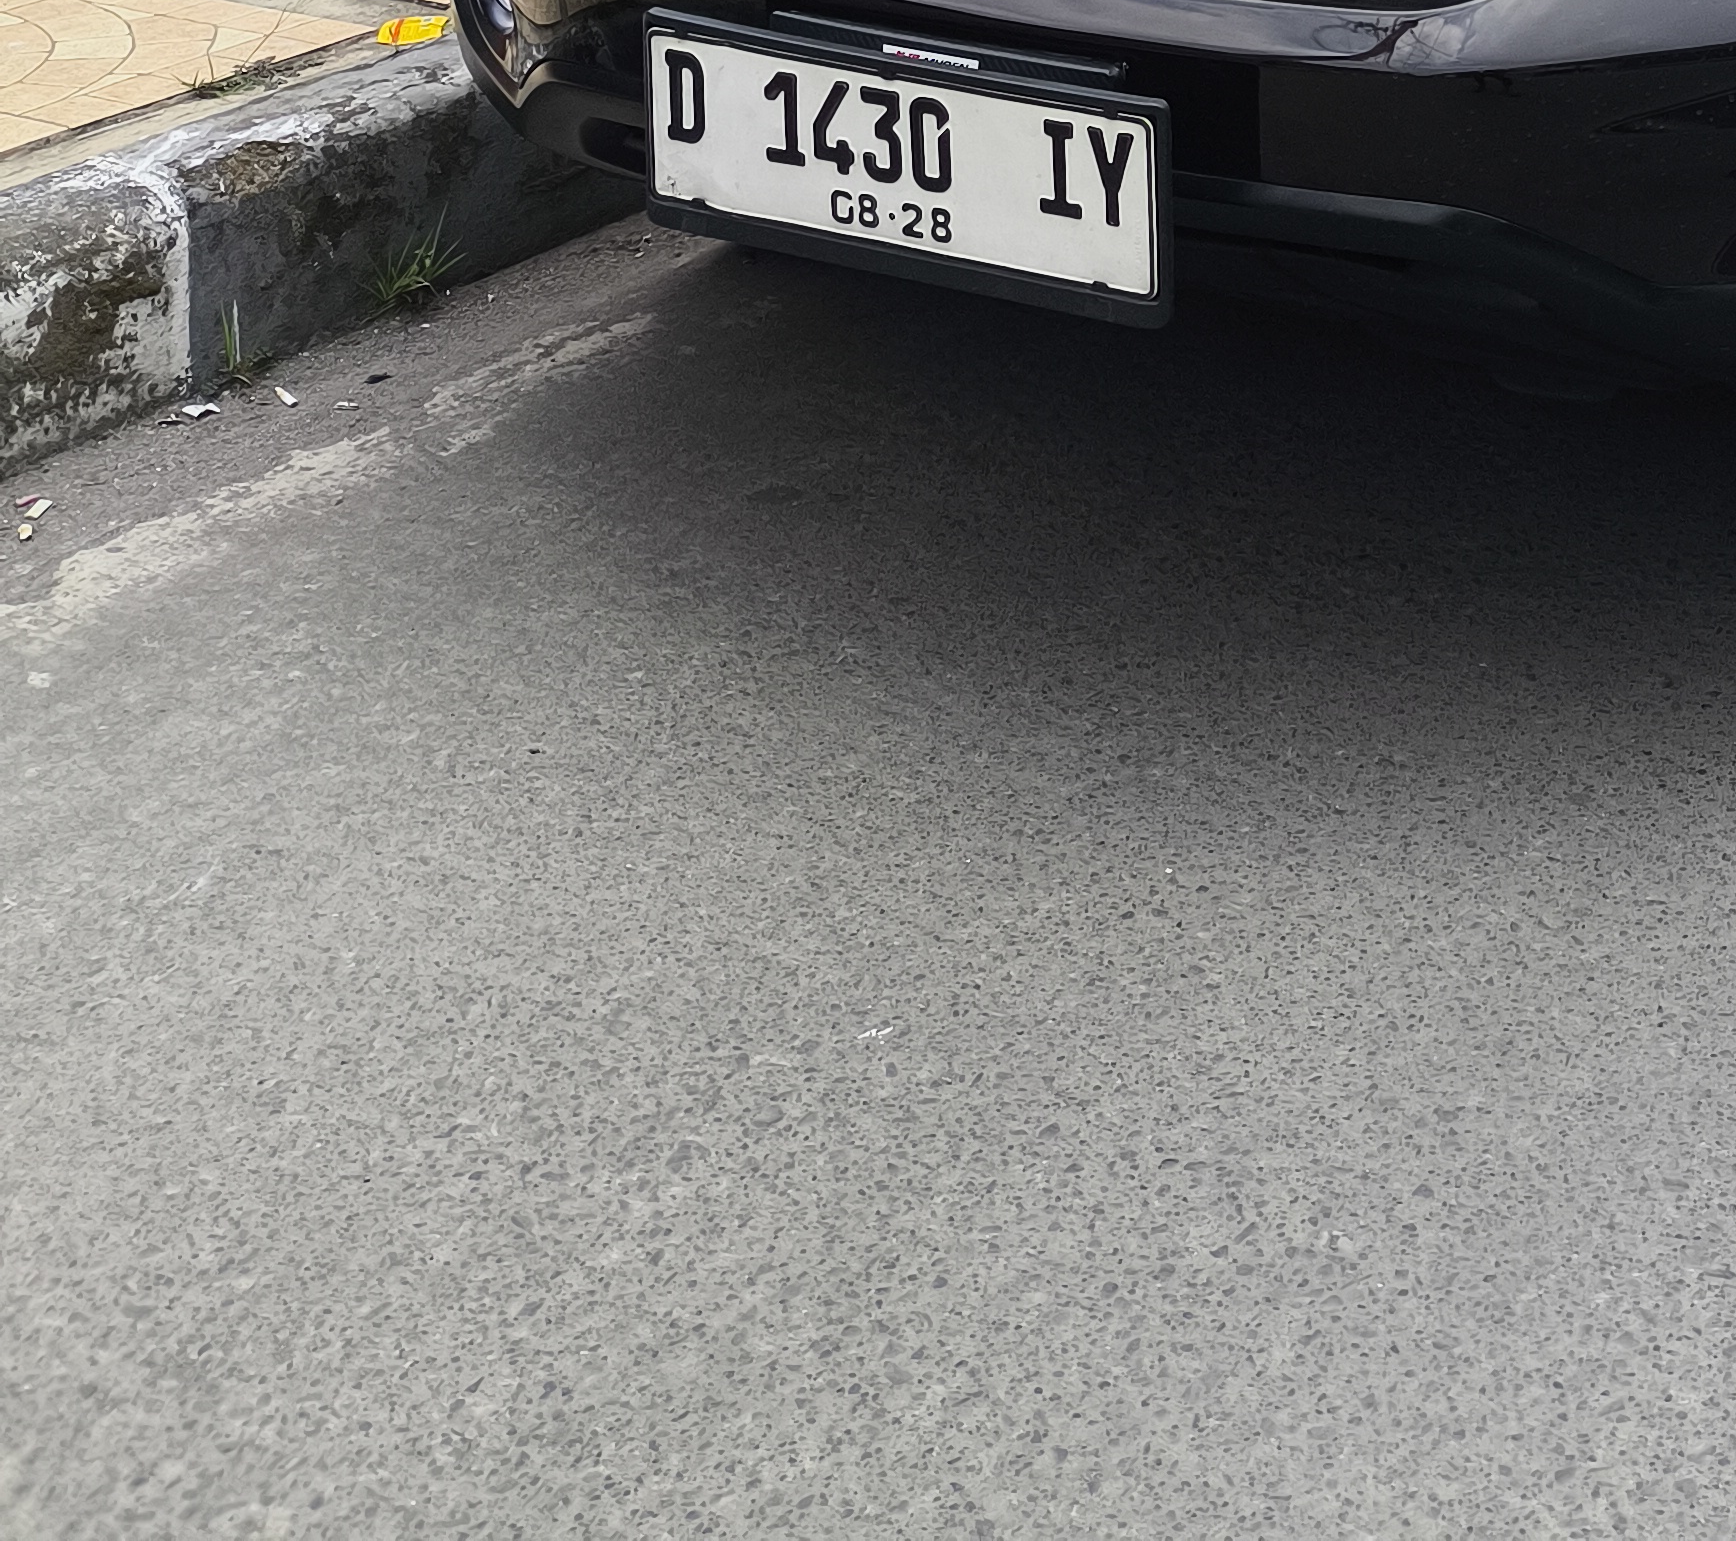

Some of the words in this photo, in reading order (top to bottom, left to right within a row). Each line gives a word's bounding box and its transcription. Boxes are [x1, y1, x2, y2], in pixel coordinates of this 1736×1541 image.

[664, 48, 705, 144] D
[763, 71, 952, 193] 1430
[1038, 118, 1135, 227] IY
